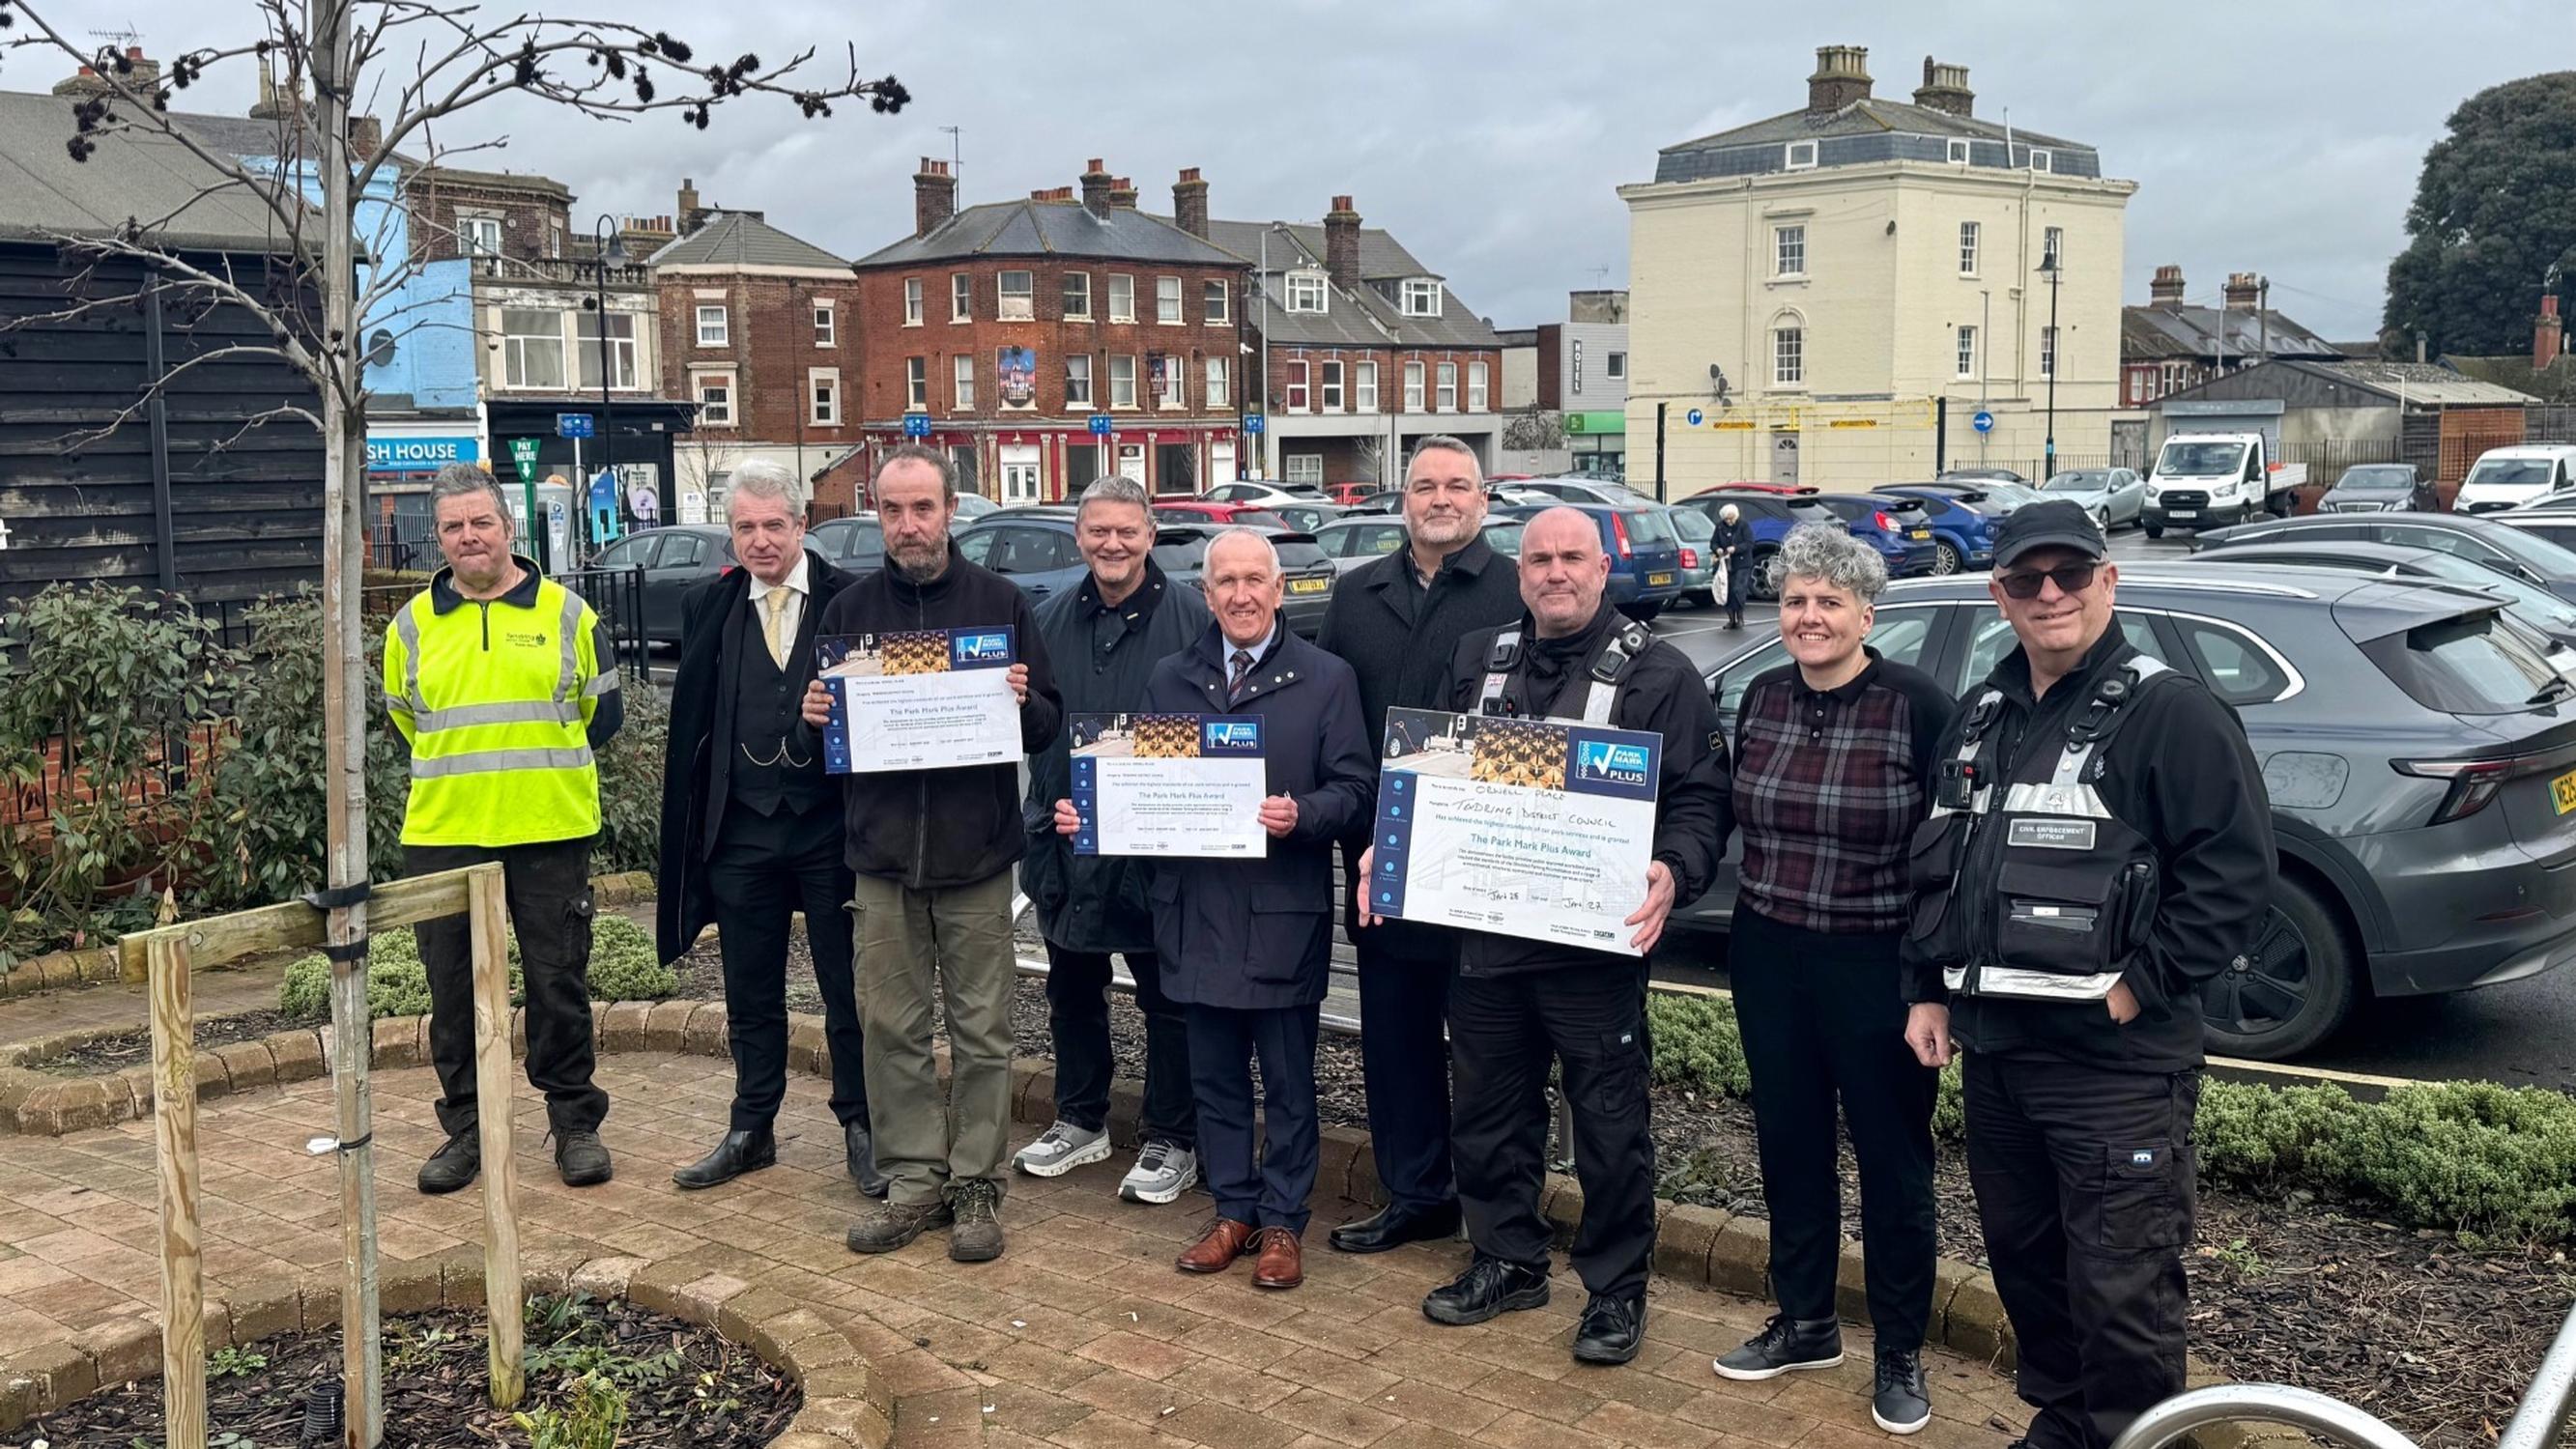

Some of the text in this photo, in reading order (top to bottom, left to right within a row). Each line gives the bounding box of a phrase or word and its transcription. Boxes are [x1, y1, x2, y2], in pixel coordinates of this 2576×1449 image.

[367, 443, 457, 460] SH HOUSE
[517, 441, 531, 451] PAY
[514, 451, 536, 461] HERE
[1614, 755, 1643, 766] MARK
[1610, 770, 1644, 782] PLUS
[1475, 785, 1524, 796] ORWELL
[1534, 789, 1565, 801] PLACE
[1522, 808, 1560, 821] DISTRICT
[1568, 814, 1617, 828] COUNCIL
[2036, 826, 2084, 835] ENFORCEMENT
[1471, 833, 1591, 859] The Park Mark Plus Award
